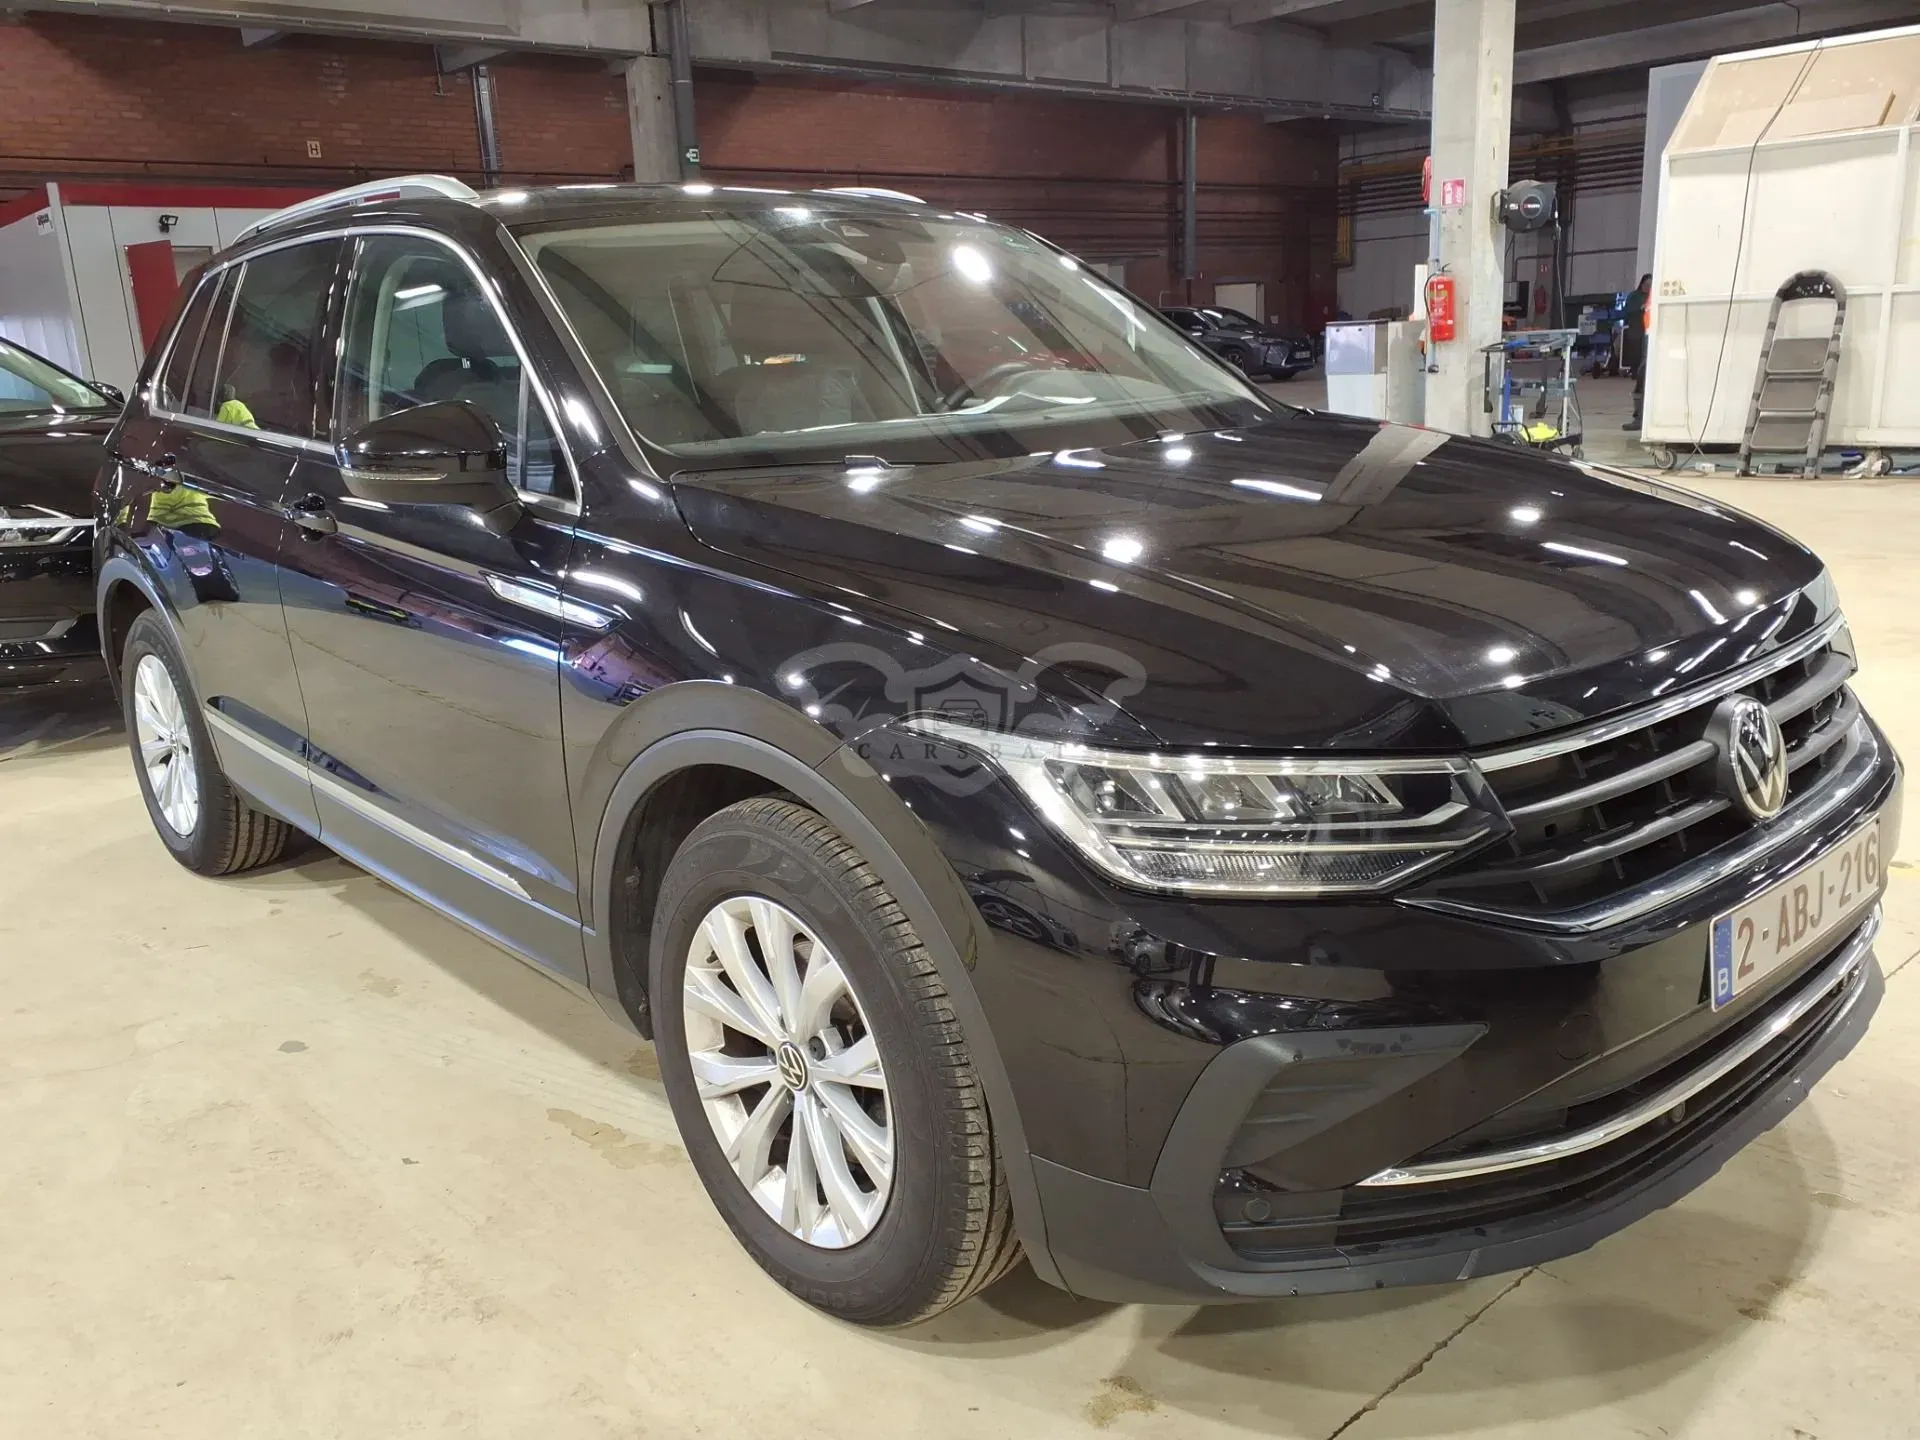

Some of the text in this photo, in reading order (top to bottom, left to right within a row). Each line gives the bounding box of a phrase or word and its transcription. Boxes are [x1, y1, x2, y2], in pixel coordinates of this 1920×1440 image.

[310, 143, 319, 155] H
[1737, 832, 1877, 980] 2-ABJ-216
[1717, 967, 1729, 996] B
